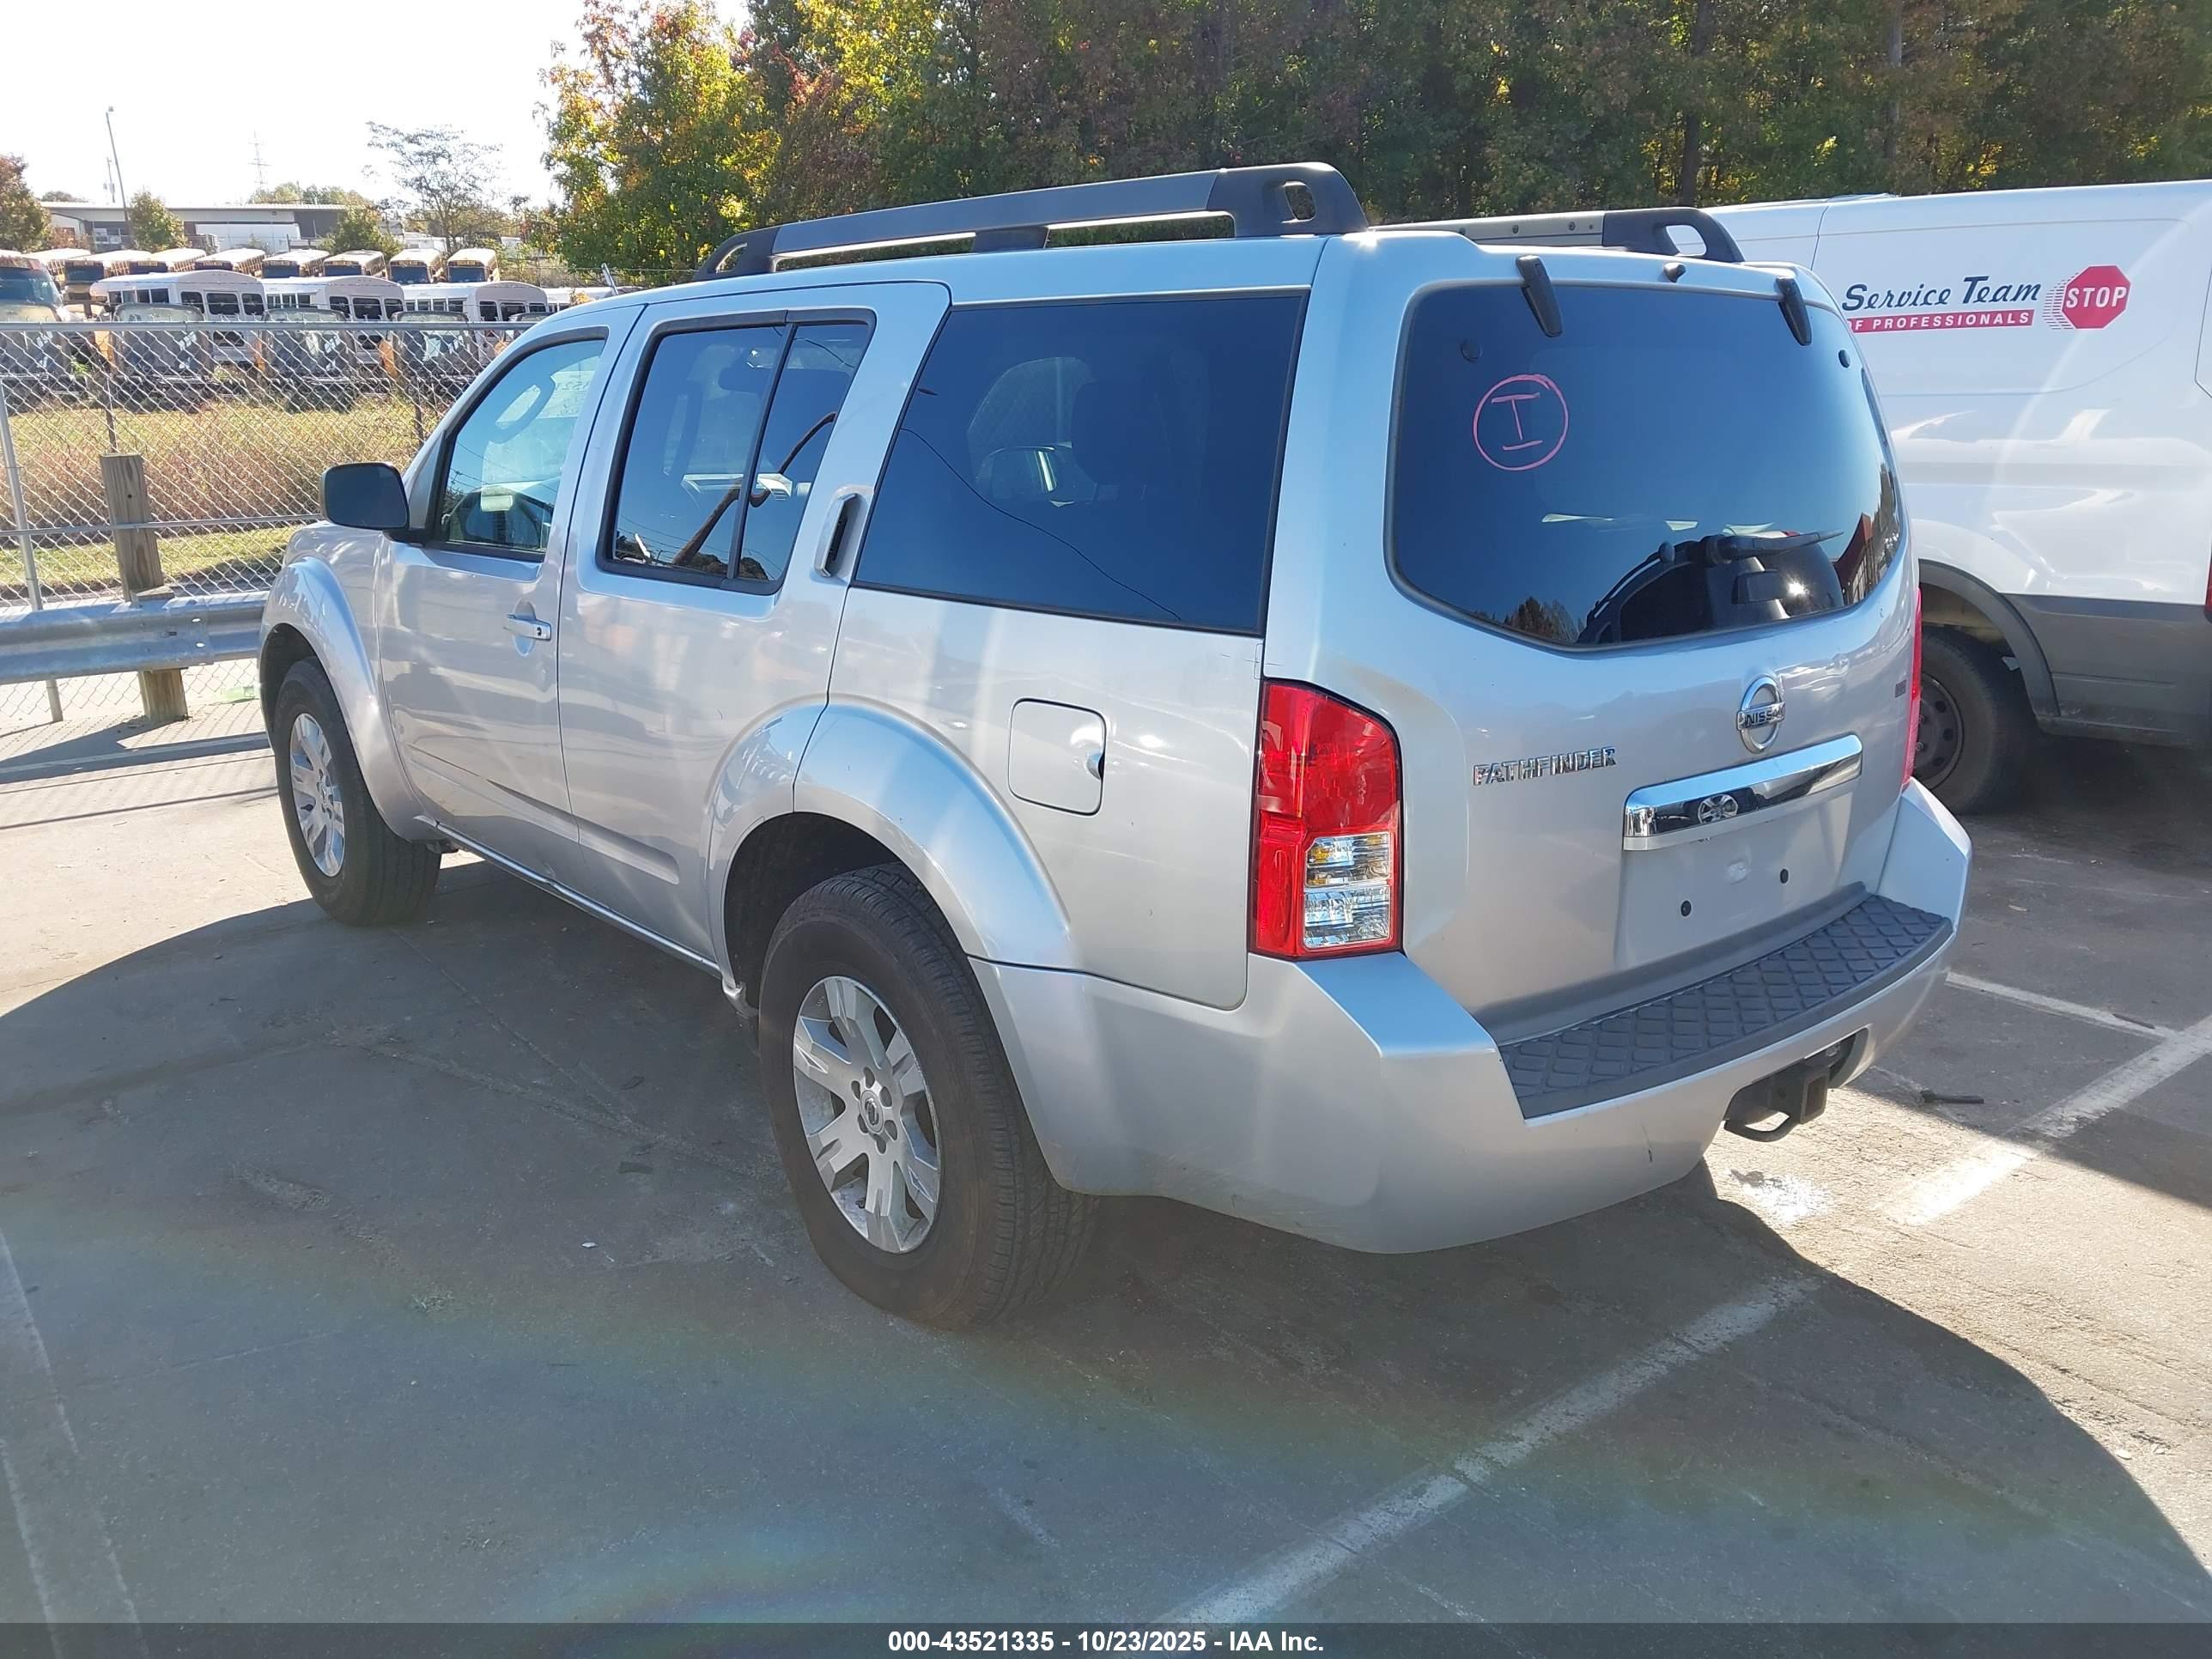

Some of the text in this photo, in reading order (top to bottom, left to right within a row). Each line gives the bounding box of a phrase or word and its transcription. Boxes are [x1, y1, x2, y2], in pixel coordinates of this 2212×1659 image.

[1842, 276, 2042, 311] Service Team
[2066, 286, 2127, 308] STOP
[1873, 312, 2030, 330] PROFESSIONALS
[1474, 746, 1616, 786] PATHFINDER
